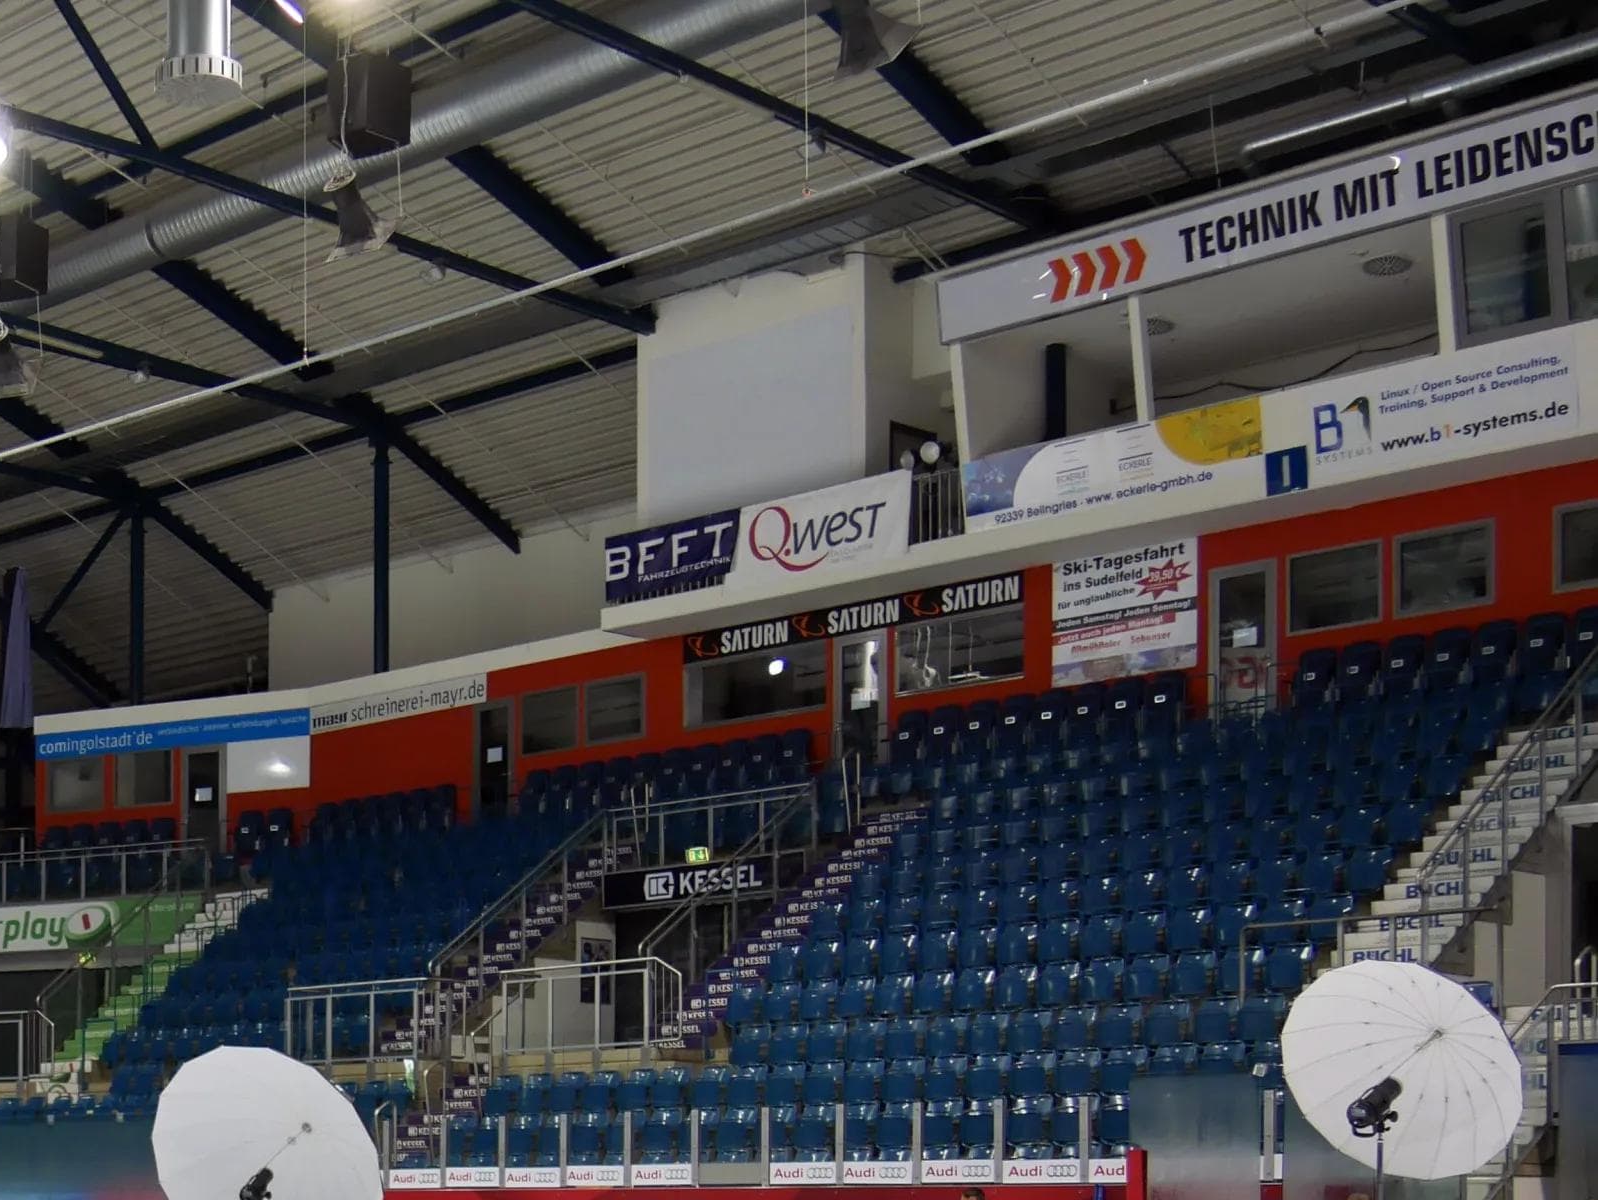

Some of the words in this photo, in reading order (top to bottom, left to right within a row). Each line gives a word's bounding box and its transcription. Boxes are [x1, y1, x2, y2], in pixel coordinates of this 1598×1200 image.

[1179, 189, 1322, 264] TECHNIK
[1334, 169, 1400, 221] MIT
[1415, 112, 1598, 199] LEIDENSC
[1381, 387, 1410, 401] Linux
[1422, 380, 1452, 395] Open
[1455, 370, 1493, 385] Source
[1431, 387, 1475, 405] Support
[1491, 366, 1569, 391] Development
[1381, 402, 1569, 451] www.b1-systems.de
[606, 520, 734, 582] BFFT
[1062, 541, 1185, 577] Ski-Tagesfahrt
[1063, 580, 1081, 593] ins
[1085, 567, 1143, 590] Sudelfeld
[941, 575, 1020, 614] SATURN
[1058, 600, 1071, 611] für
[1073, 586, 1135, 607] unglaubliche
[827, 598, 900, 635] SATURN
[719, 620, 789, 655] SATURN
[351, 680, 485, 722] schreinerei-mayr.de
[680, 865, 762, 895] KESSEL
[393, 1173, 415, 1184] Audi
[448, 1171, 473, 1183] Audi
[506, 1172, 532, 1184] Audi
[568, 1170, 594, 1182] Audi
[635, 1169, 662, 1182] Audi
[773, 1167, 804, 1179] Audi
[844, 1167, 876, 1179] Audi
[925, 1165, 958, 1177] Audi
[1008, 1164, 1043, 1177] Audi
[1094, 1164, 1125, 1177] Aud
